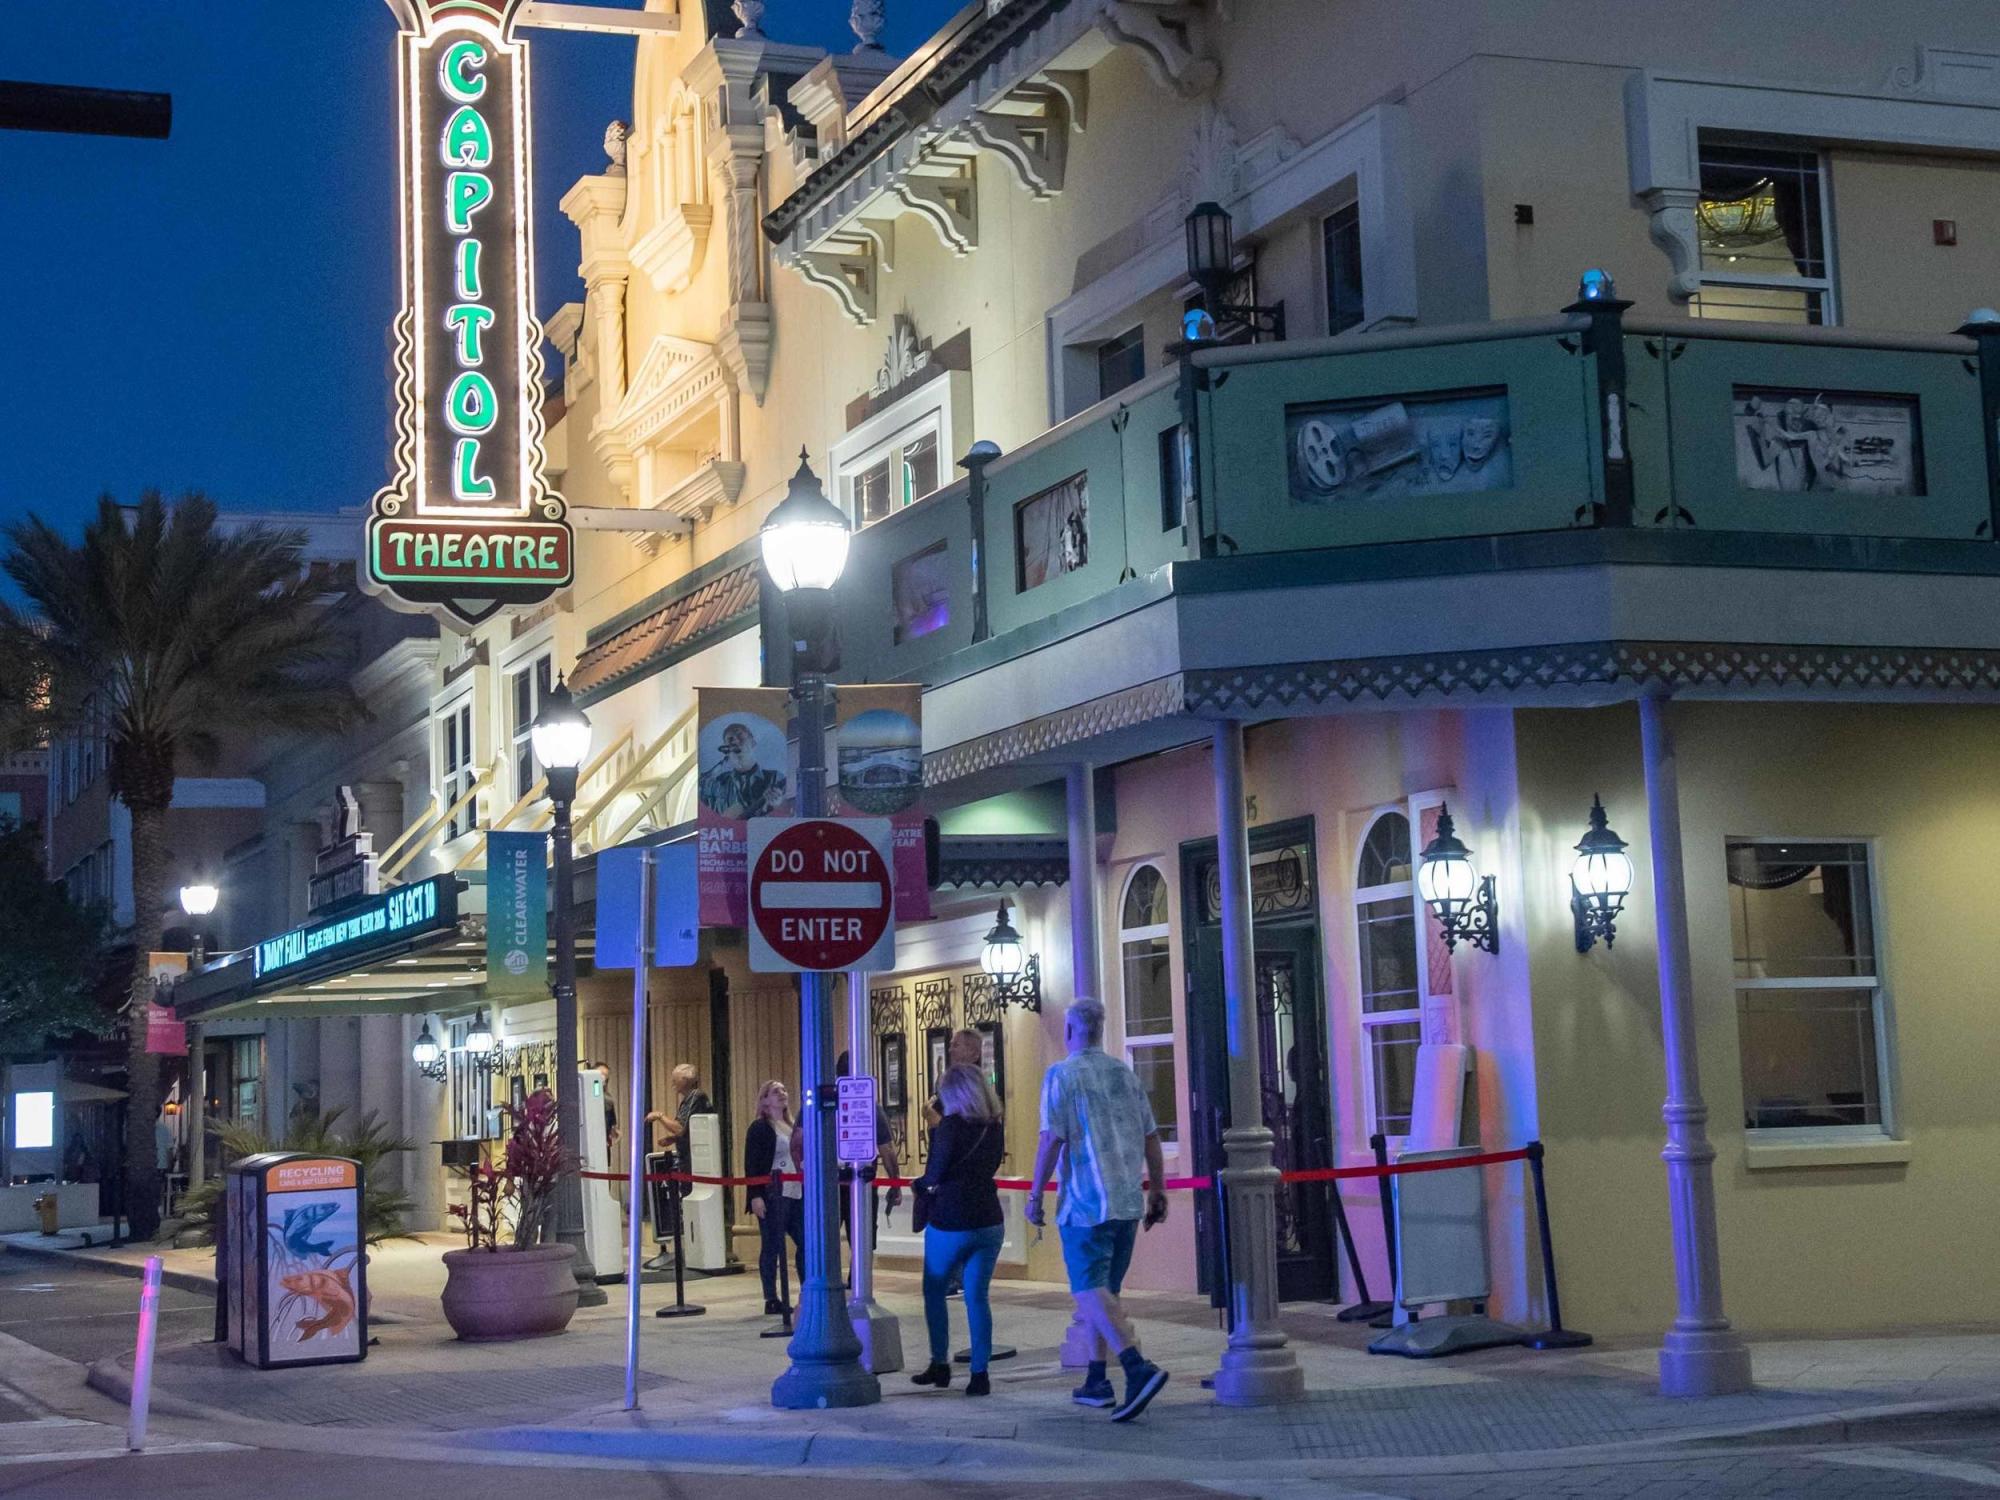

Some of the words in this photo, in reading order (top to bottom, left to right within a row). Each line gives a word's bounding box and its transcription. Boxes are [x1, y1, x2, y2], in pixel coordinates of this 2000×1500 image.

[441, 41, 498, 500] CAPITOL
[388, 531, 560, 570] THEATRE
[700, 828, 734, 841] SAM
[771, 849, 804, 874] DO
[824, 849, 871, 874] NOT
[389, 892, 405, 931] SAT
[406, 885, 424, 926] OCT
[425, 881, 436, 919] 10
[515, 848, 529, 946] CLEARWATER
[781, 917, 863, 942] ENTER
[280, 1166, 344, 1178] RECYCLING
